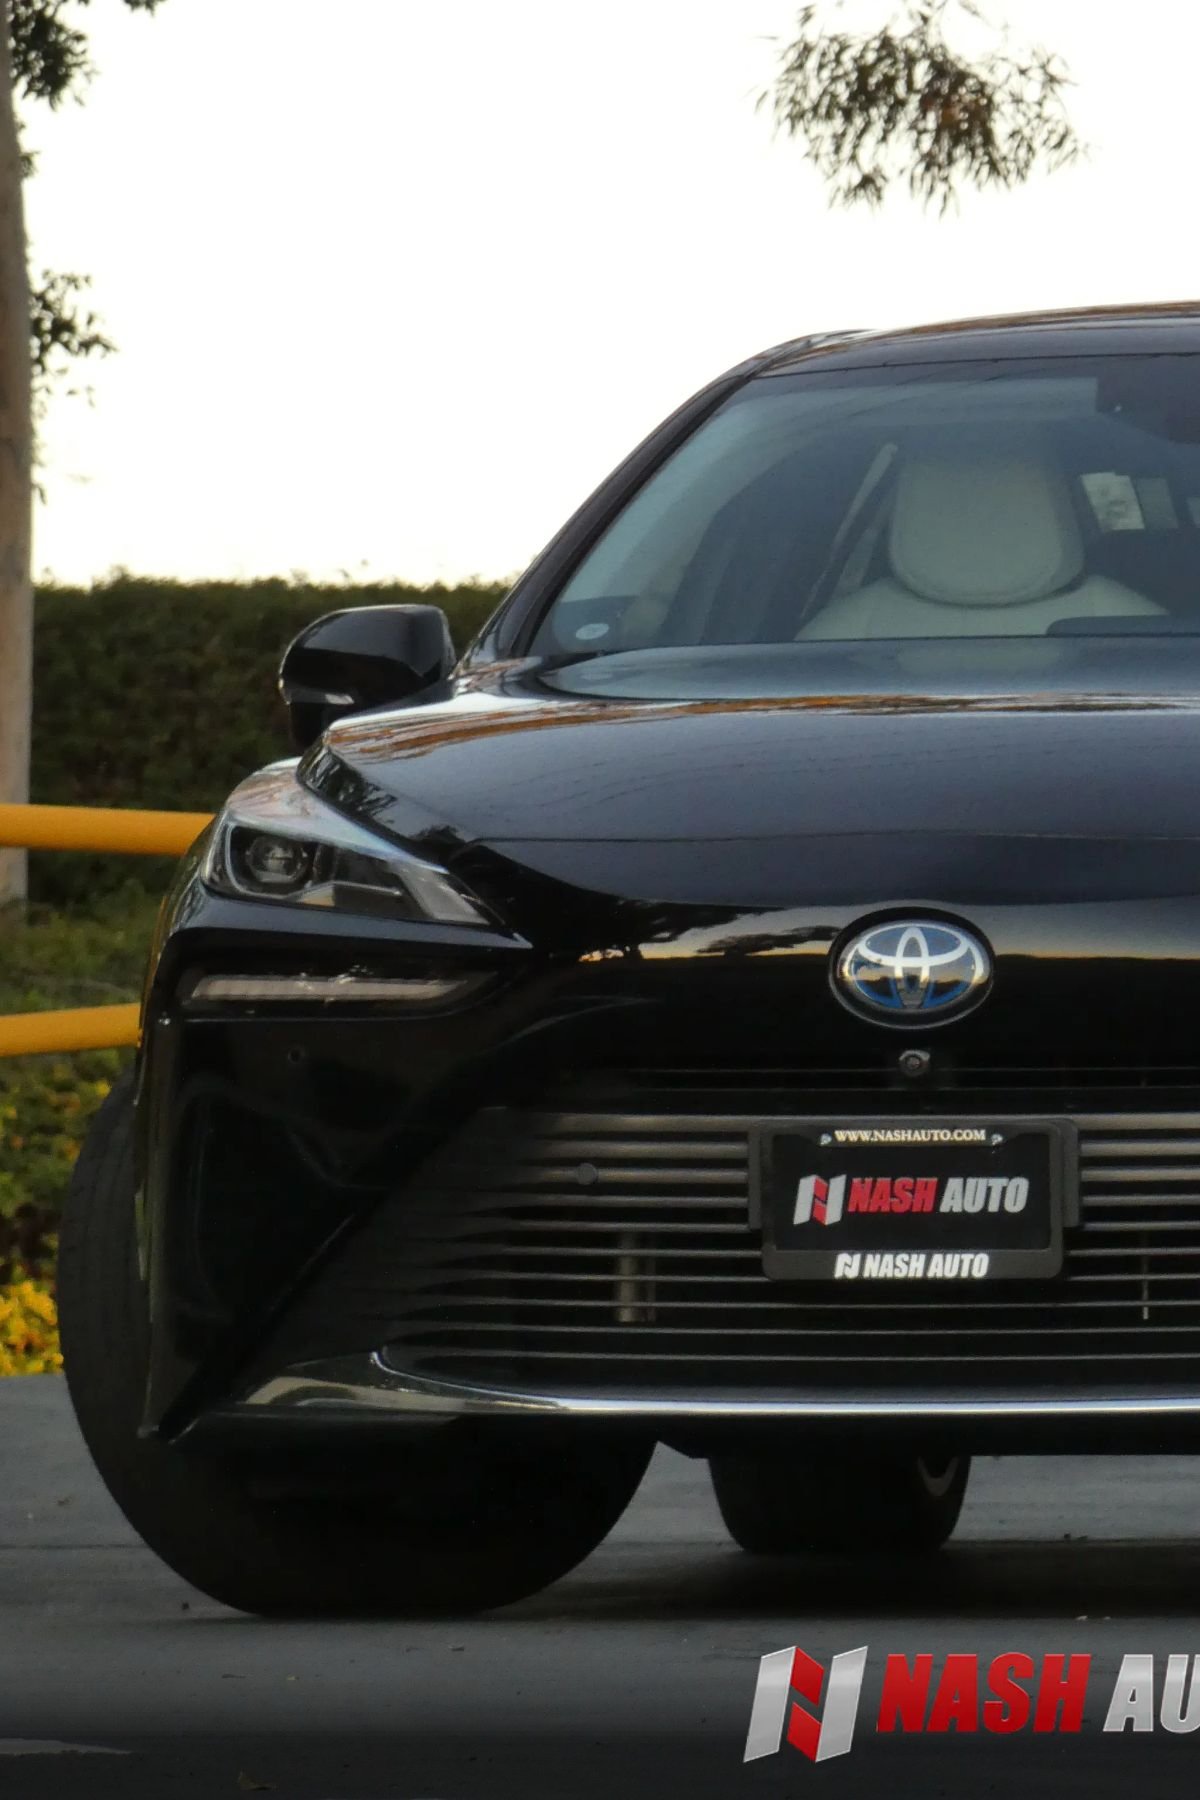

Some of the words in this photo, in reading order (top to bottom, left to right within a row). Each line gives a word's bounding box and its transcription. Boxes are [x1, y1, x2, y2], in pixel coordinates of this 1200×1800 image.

[834, 1129, 986, 1142] WWW.NASHAUTO.COM
[848, 1177, 938, 1213] NASH
[939, 1176, 1029, 1213] AUTO
[863, 1253, 926, 1279] NASH
[927, 1252, 989, 1279] AUTO
